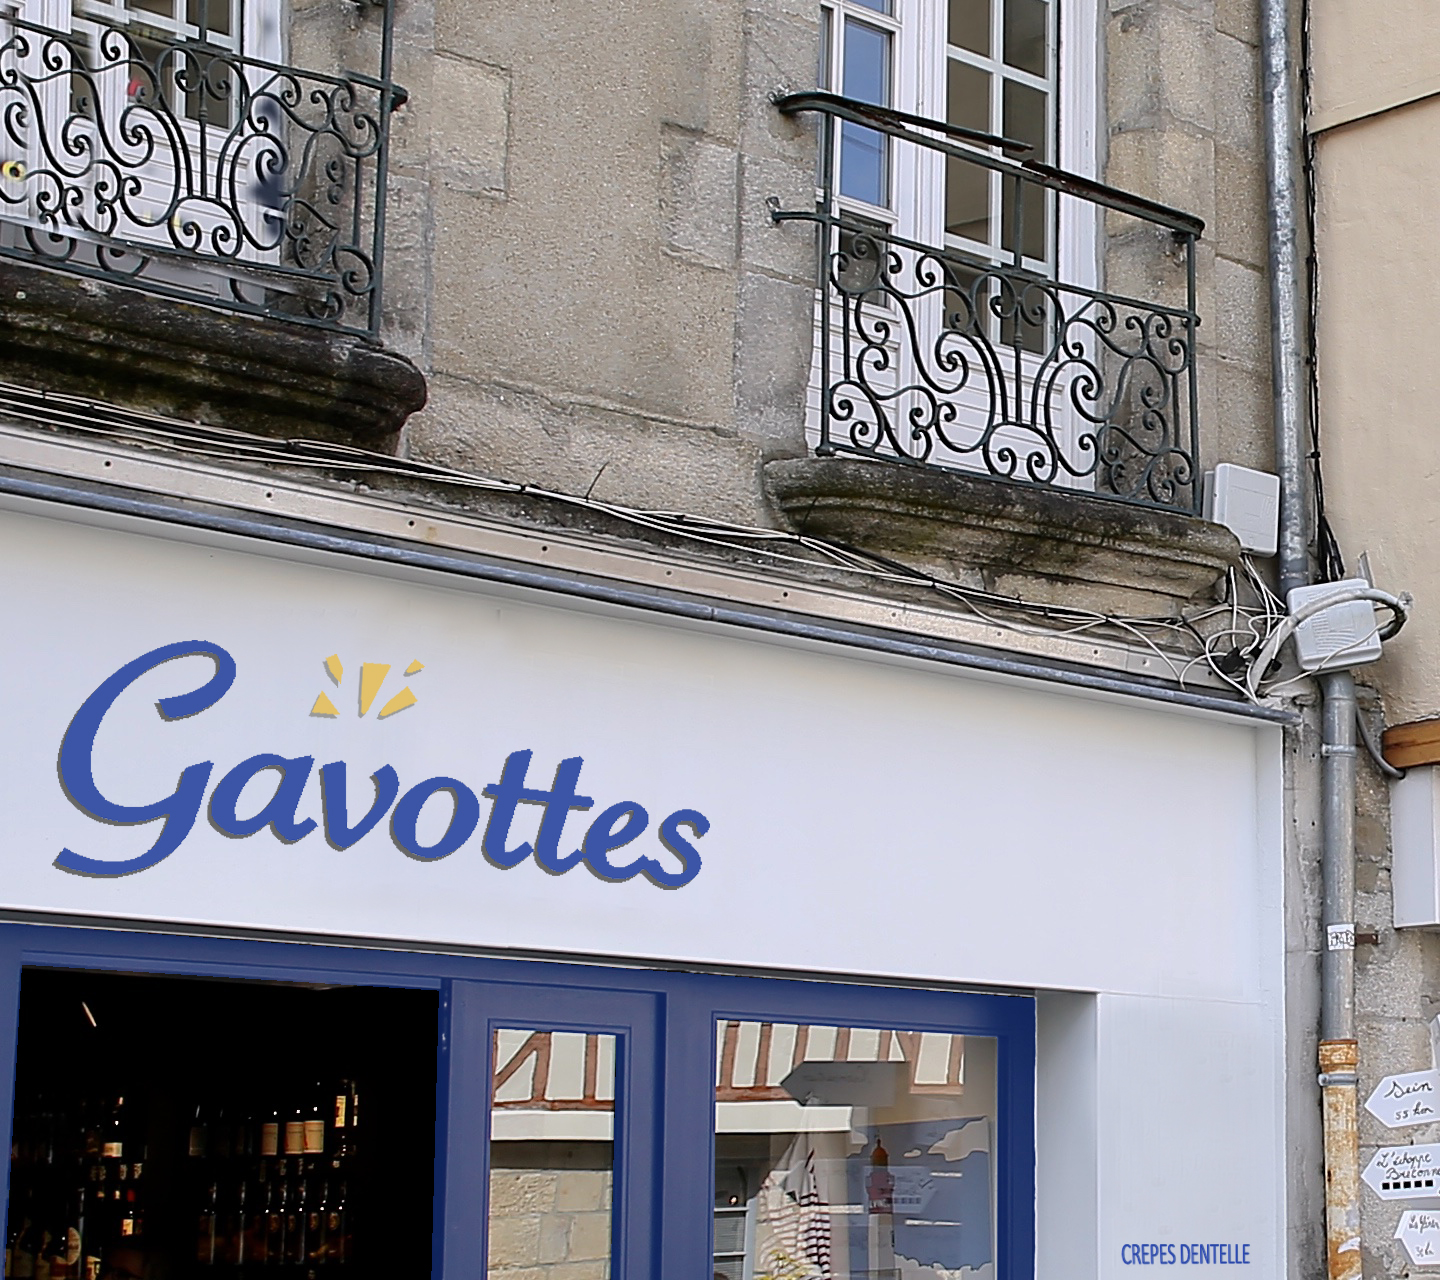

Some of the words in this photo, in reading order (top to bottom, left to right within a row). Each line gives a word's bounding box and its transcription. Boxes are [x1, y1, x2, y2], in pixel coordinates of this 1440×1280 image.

[54, 639, 711, 890] Gavottes
[1384, 1080, 1433, 1099] Sein
[1122, 1244, 1176, 1265] CREPES
[1180, 1244, 1250, 1264] DENTELLE
